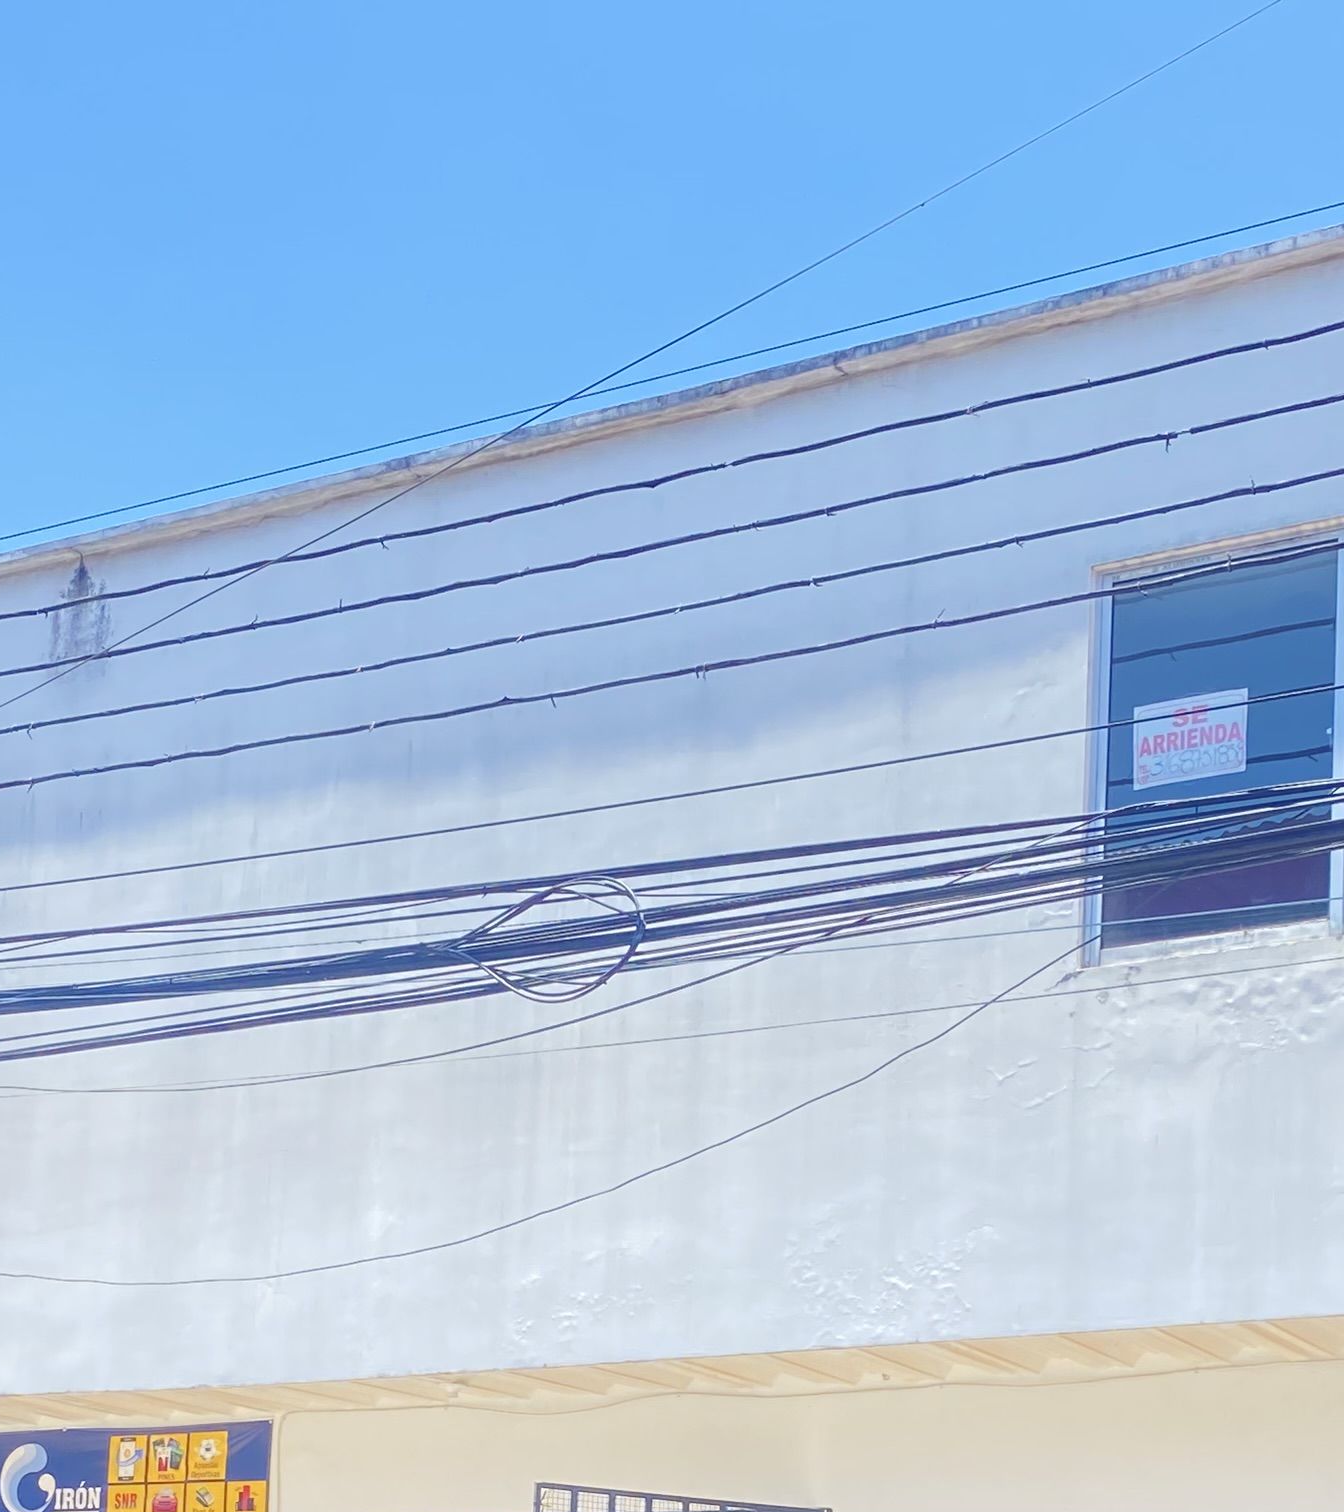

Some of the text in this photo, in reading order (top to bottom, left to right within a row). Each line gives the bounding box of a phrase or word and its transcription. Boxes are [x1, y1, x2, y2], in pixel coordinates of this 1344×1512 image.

[1172, 704, 1208, 727] SE
[1140, 721, 1243, 757] ARRIENDA
[114, 1492, 137, 1510] SNR
